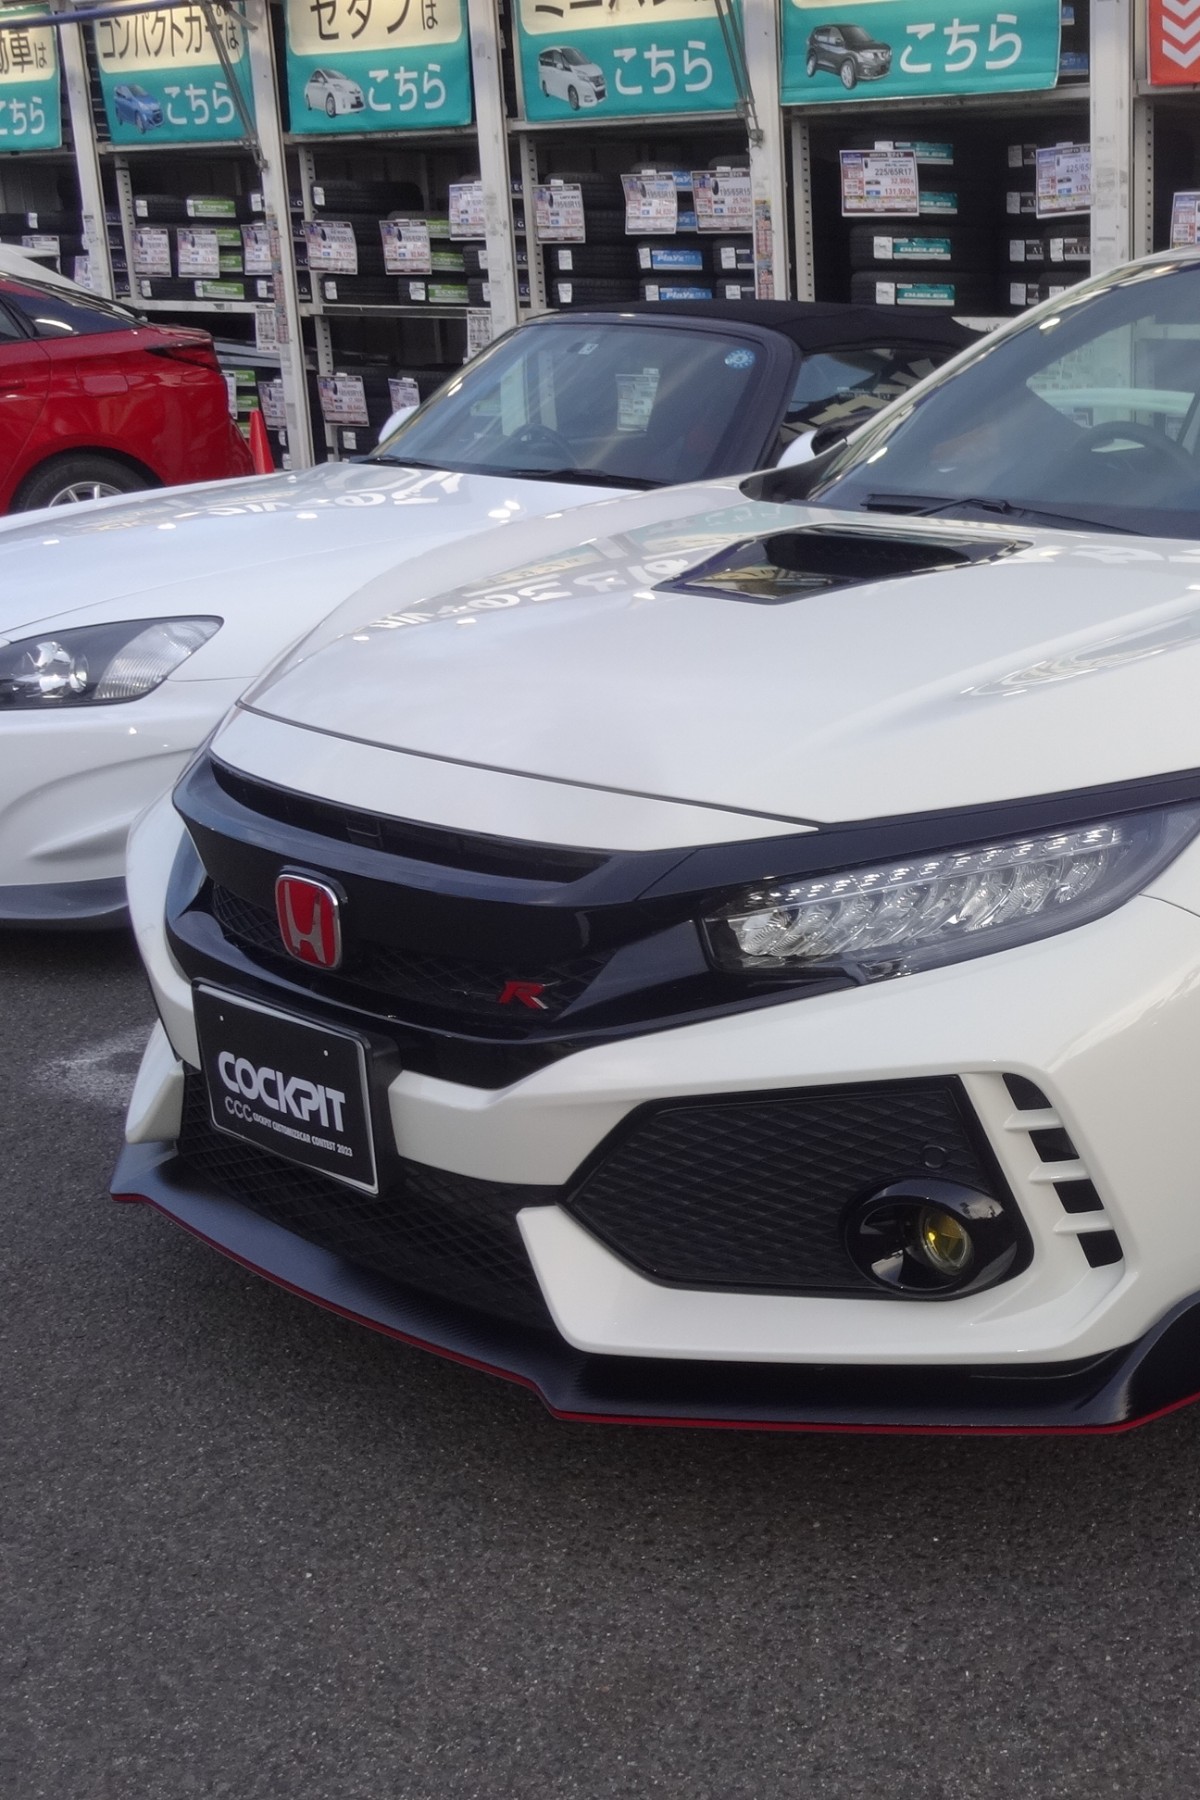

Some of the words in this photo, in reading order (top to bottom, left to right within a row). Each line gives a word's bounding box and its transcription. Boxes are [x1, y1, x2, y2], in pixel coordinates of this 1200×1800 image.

[613, 40, 713, 95] こちら
[899, 14, 1022, 73] こちら
[164, 81, 236, 125] こちら
[368, 64, 446, 111] こちら
[874, 168, 913, 177] 225/65R17
[218, 1051, 346, 1132] COCKPIT
[224, 1095, 253, 1123] CCC
[311, 1135, 336, 1152] CONTEST
[336, 1143, 353, 1157] 2023
